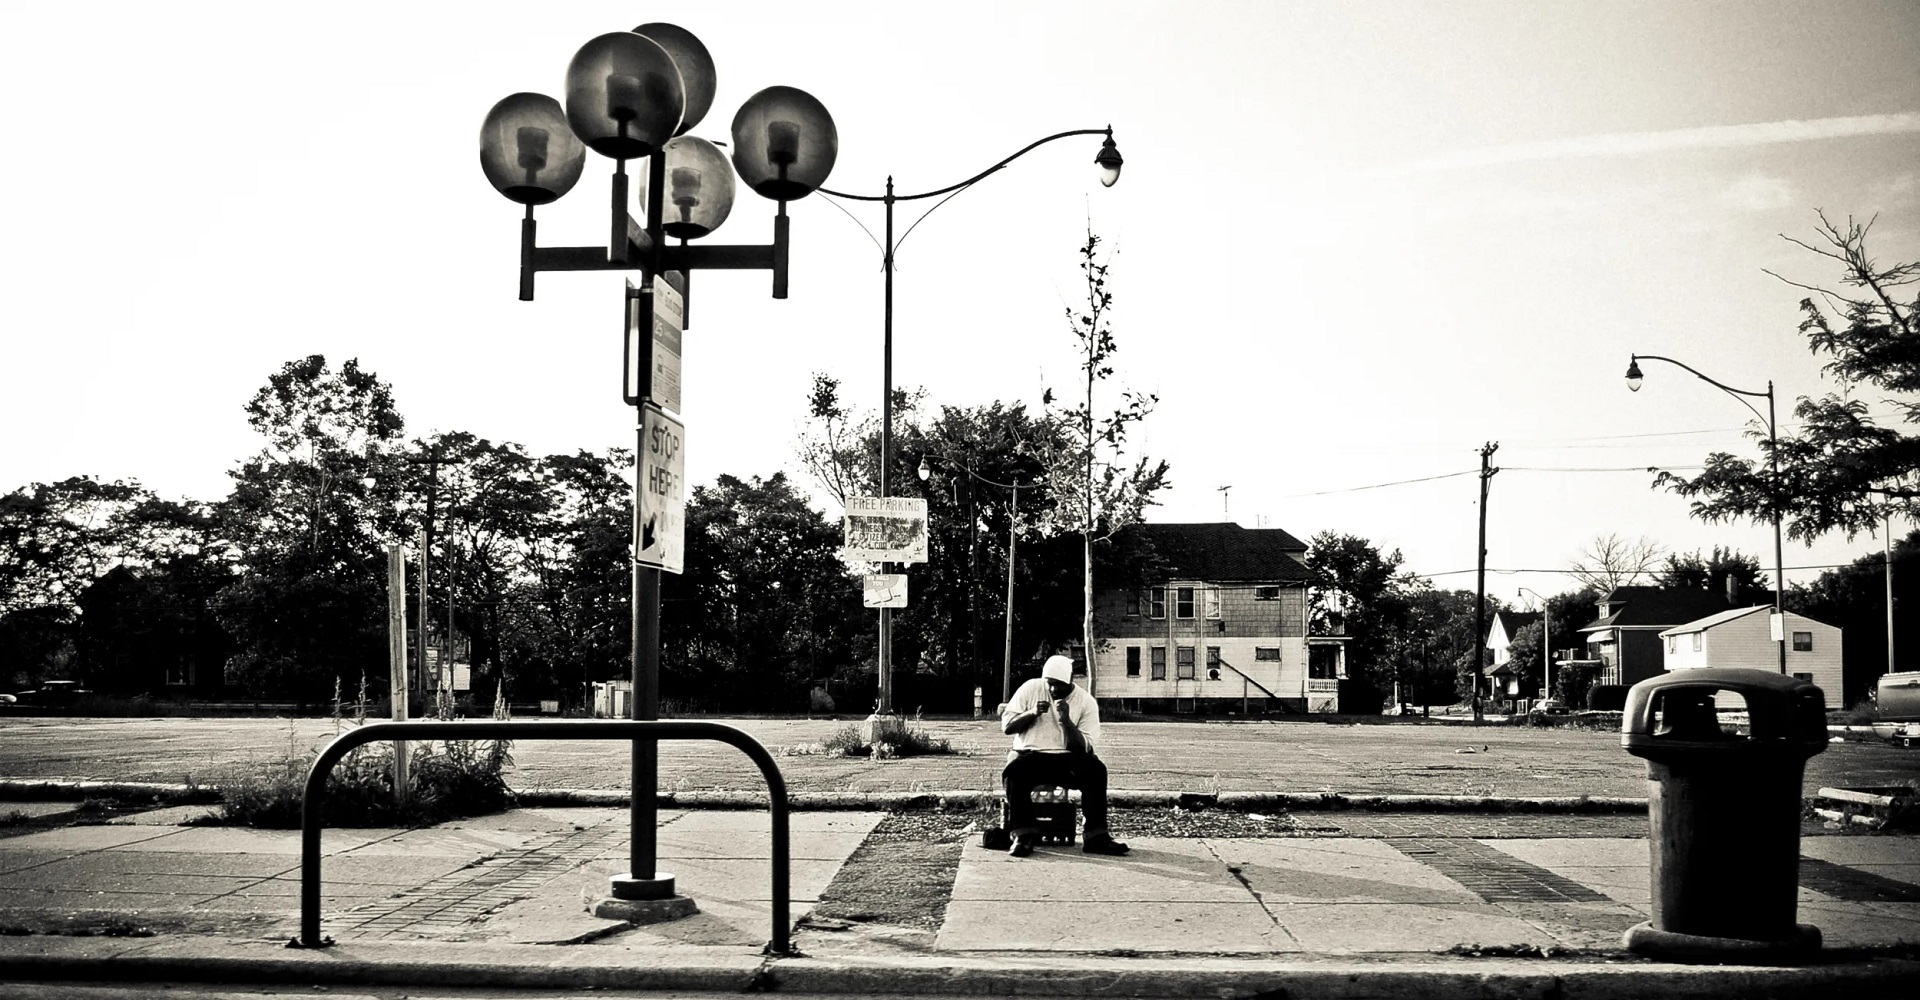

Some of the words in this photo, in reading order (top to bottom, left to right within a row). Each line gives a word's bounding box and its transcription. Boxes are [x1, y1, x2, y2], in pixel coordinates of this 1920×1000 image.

[651, 425, 680, 461] STOP
[649, 464, 680, 501] HERE
[853, 498, 877, 510] FREE
[880, 499, 920, 512] PARKING
